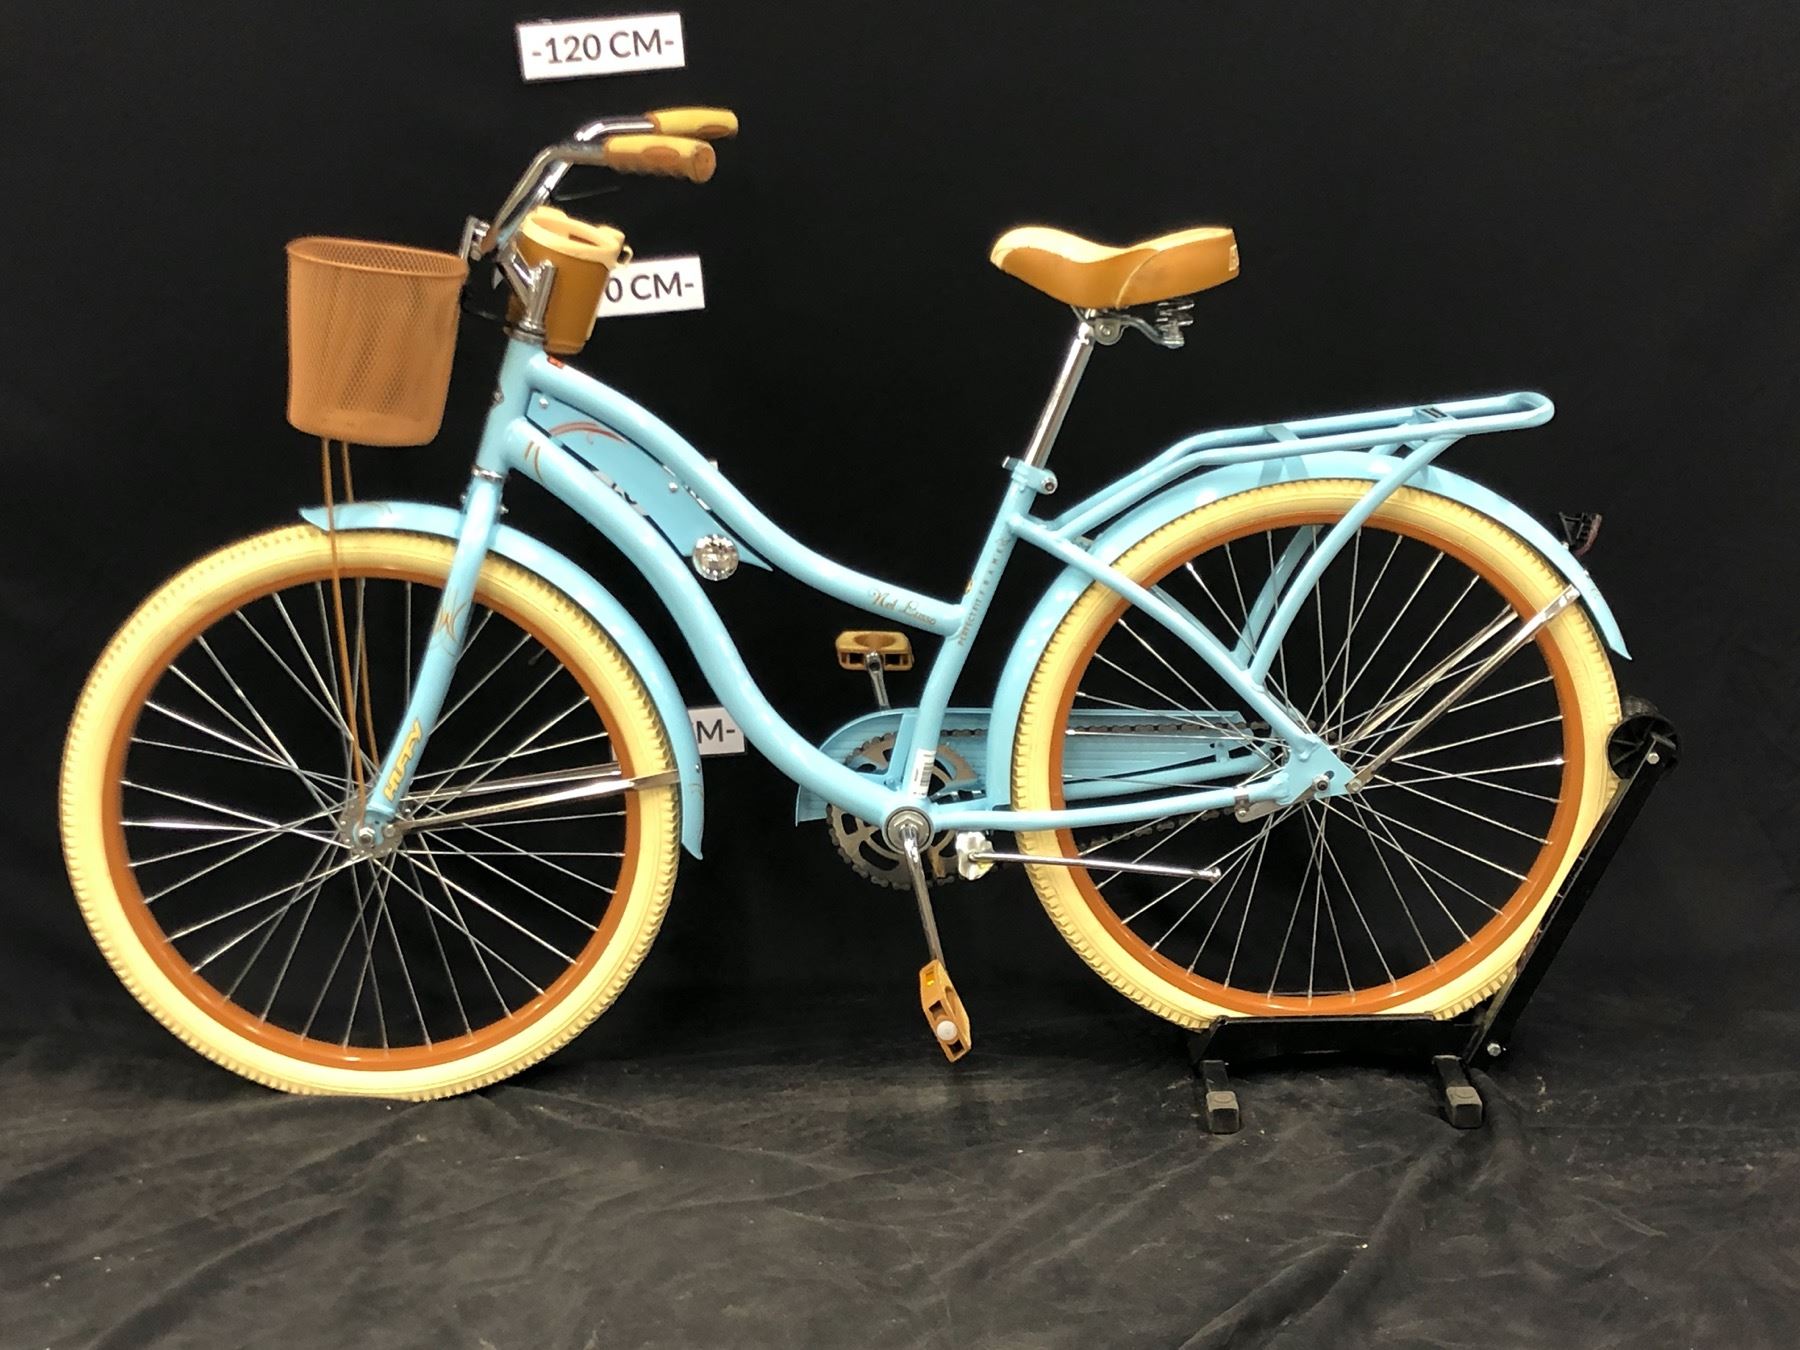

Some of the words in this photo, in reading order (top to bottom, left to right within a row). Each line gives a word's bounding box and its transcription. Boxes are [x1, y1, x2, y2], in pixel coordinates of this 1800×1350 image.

[532, 34, 601, 64] -120
[609, 28, 674, 58] CM-
[630, 271, 694, 300] CM-
[696, 718, 736, 744] M-
[382, 718, 424, 802] HUFFY
